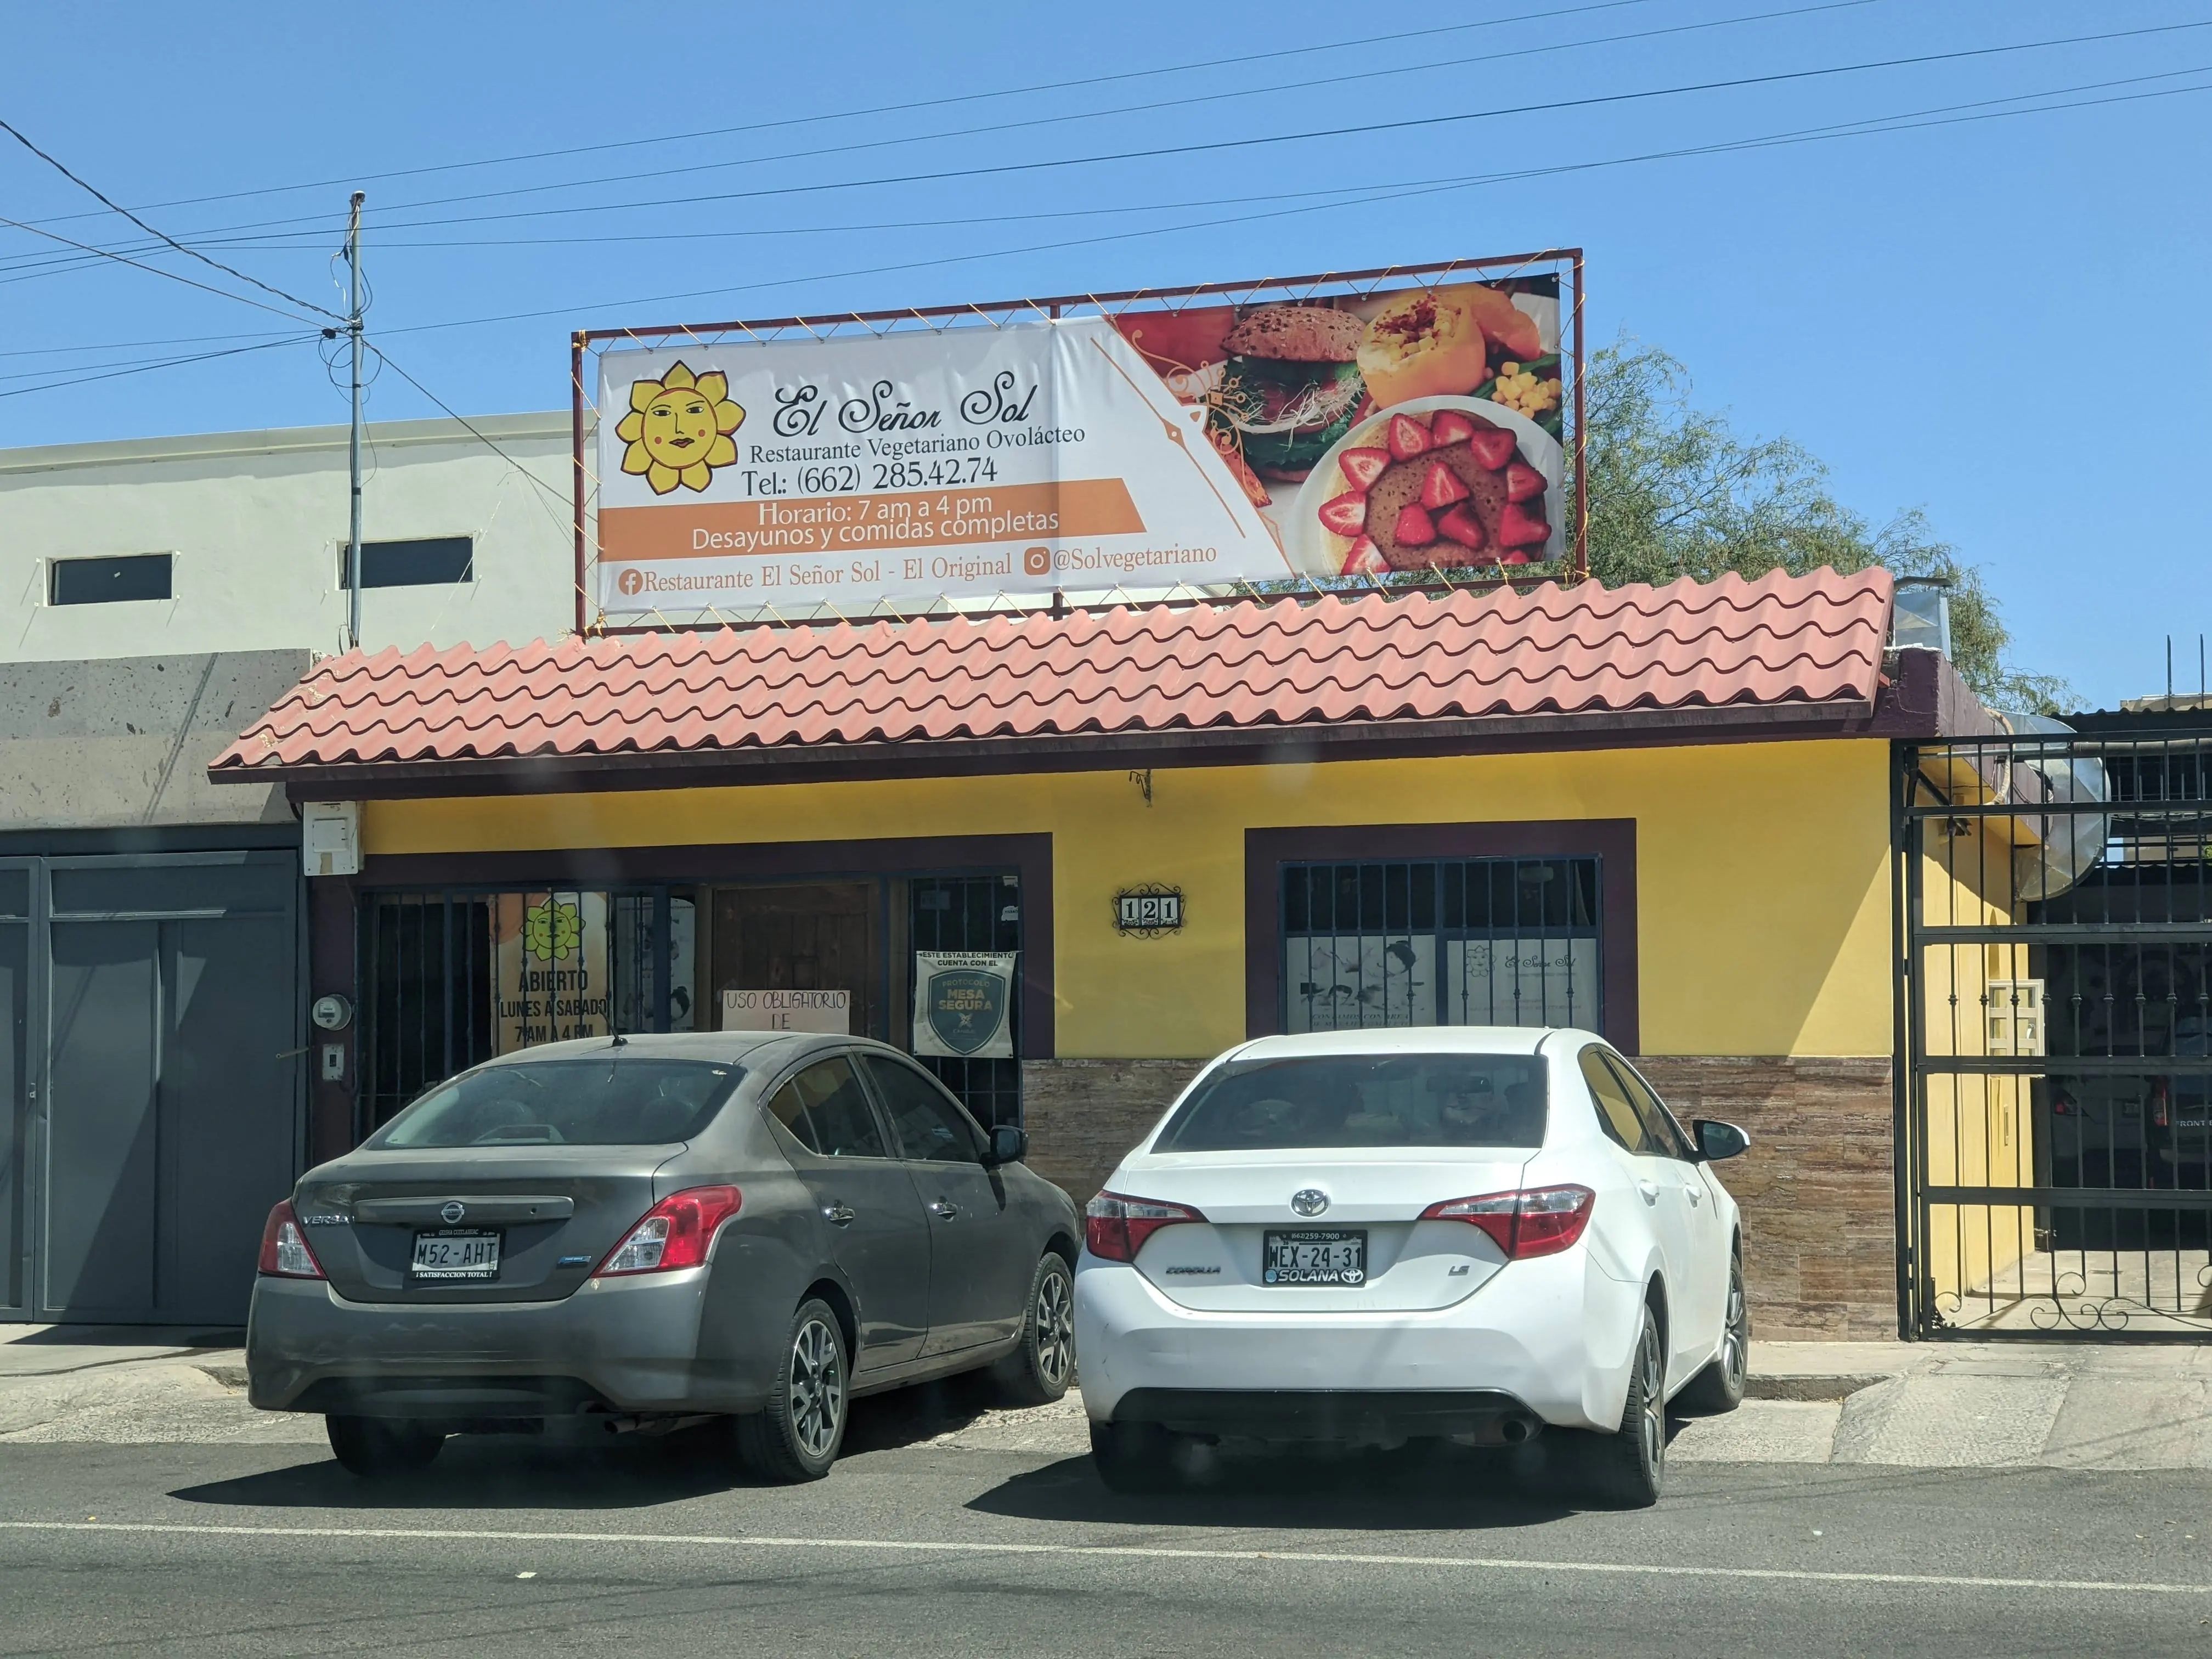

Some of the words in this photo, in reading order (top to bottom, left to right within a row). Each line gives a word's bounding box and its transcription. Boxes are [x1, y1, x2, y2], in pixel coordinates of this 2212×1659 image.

[773, 385, 827, 437] El
[838, 380, 942, 433] Señor
[960, 370, 1038, 425] Sol
[749, 442, 861, 464] Restaurante
[866, 433, 980, 460] Vegetariano
[986, 426, 1085, 449] Ovolácteo
[741, 470, 787, 496] Tel.:
[798, 463, 861, 495] (662)
[872, 455, 998, 489] 285.42.74
[759, 501, 852, 526] Horario:
[858, 500, 871, 520] 7
[877, 501, 911, 520] am
[918, 501, 929, 517] a
[936, 495, 950, 516] 4
[956, 496, 992, 520] pm
[693, 527, 814, 553] Desayunos
[821, 527, 833, 549] y
[839, 516, 934, 543] comidas
[940, 510, 1058, 539] completas
[1053, 543, 1217, 572] @Solvegetariano
[644, 571, 753, 591] Restaurante
[761, 565, 782, 586] El
[789, 565, 843, 585] Señor
[851, 560, 881, 583] Sol
[903, 558, 923, 580] El
[932, 552, 1012, 582] Original
[1126, 900, 1174, 918] 121
[518, 970, 588, 992] ABIERTO
[942, 979, 990, 988] PROTOCOLO
[727, 992, 757, 1009] USO
[763, 991, 847, 1009] OBLIGATORIO
[947, 989, 985, 999] MESA
[500, 1000, 540, 1018] LUNES
[938, 1000, 993, 1011] SEGURA
[772, 1013, 791, 1030] DE
[515, 1026, 523, 1042] 7
[527, 1025, 546, 1042] AM
[562, 1024, 571, 1040] 4
[303, 1215, 350, 1224] VERSA
[416, 1243, 495, 1265] M52-AHT
[1269, 1246, 1362, 1268] WEX-24-31
[1278, 1269, 1339, 1282] SOLANA
